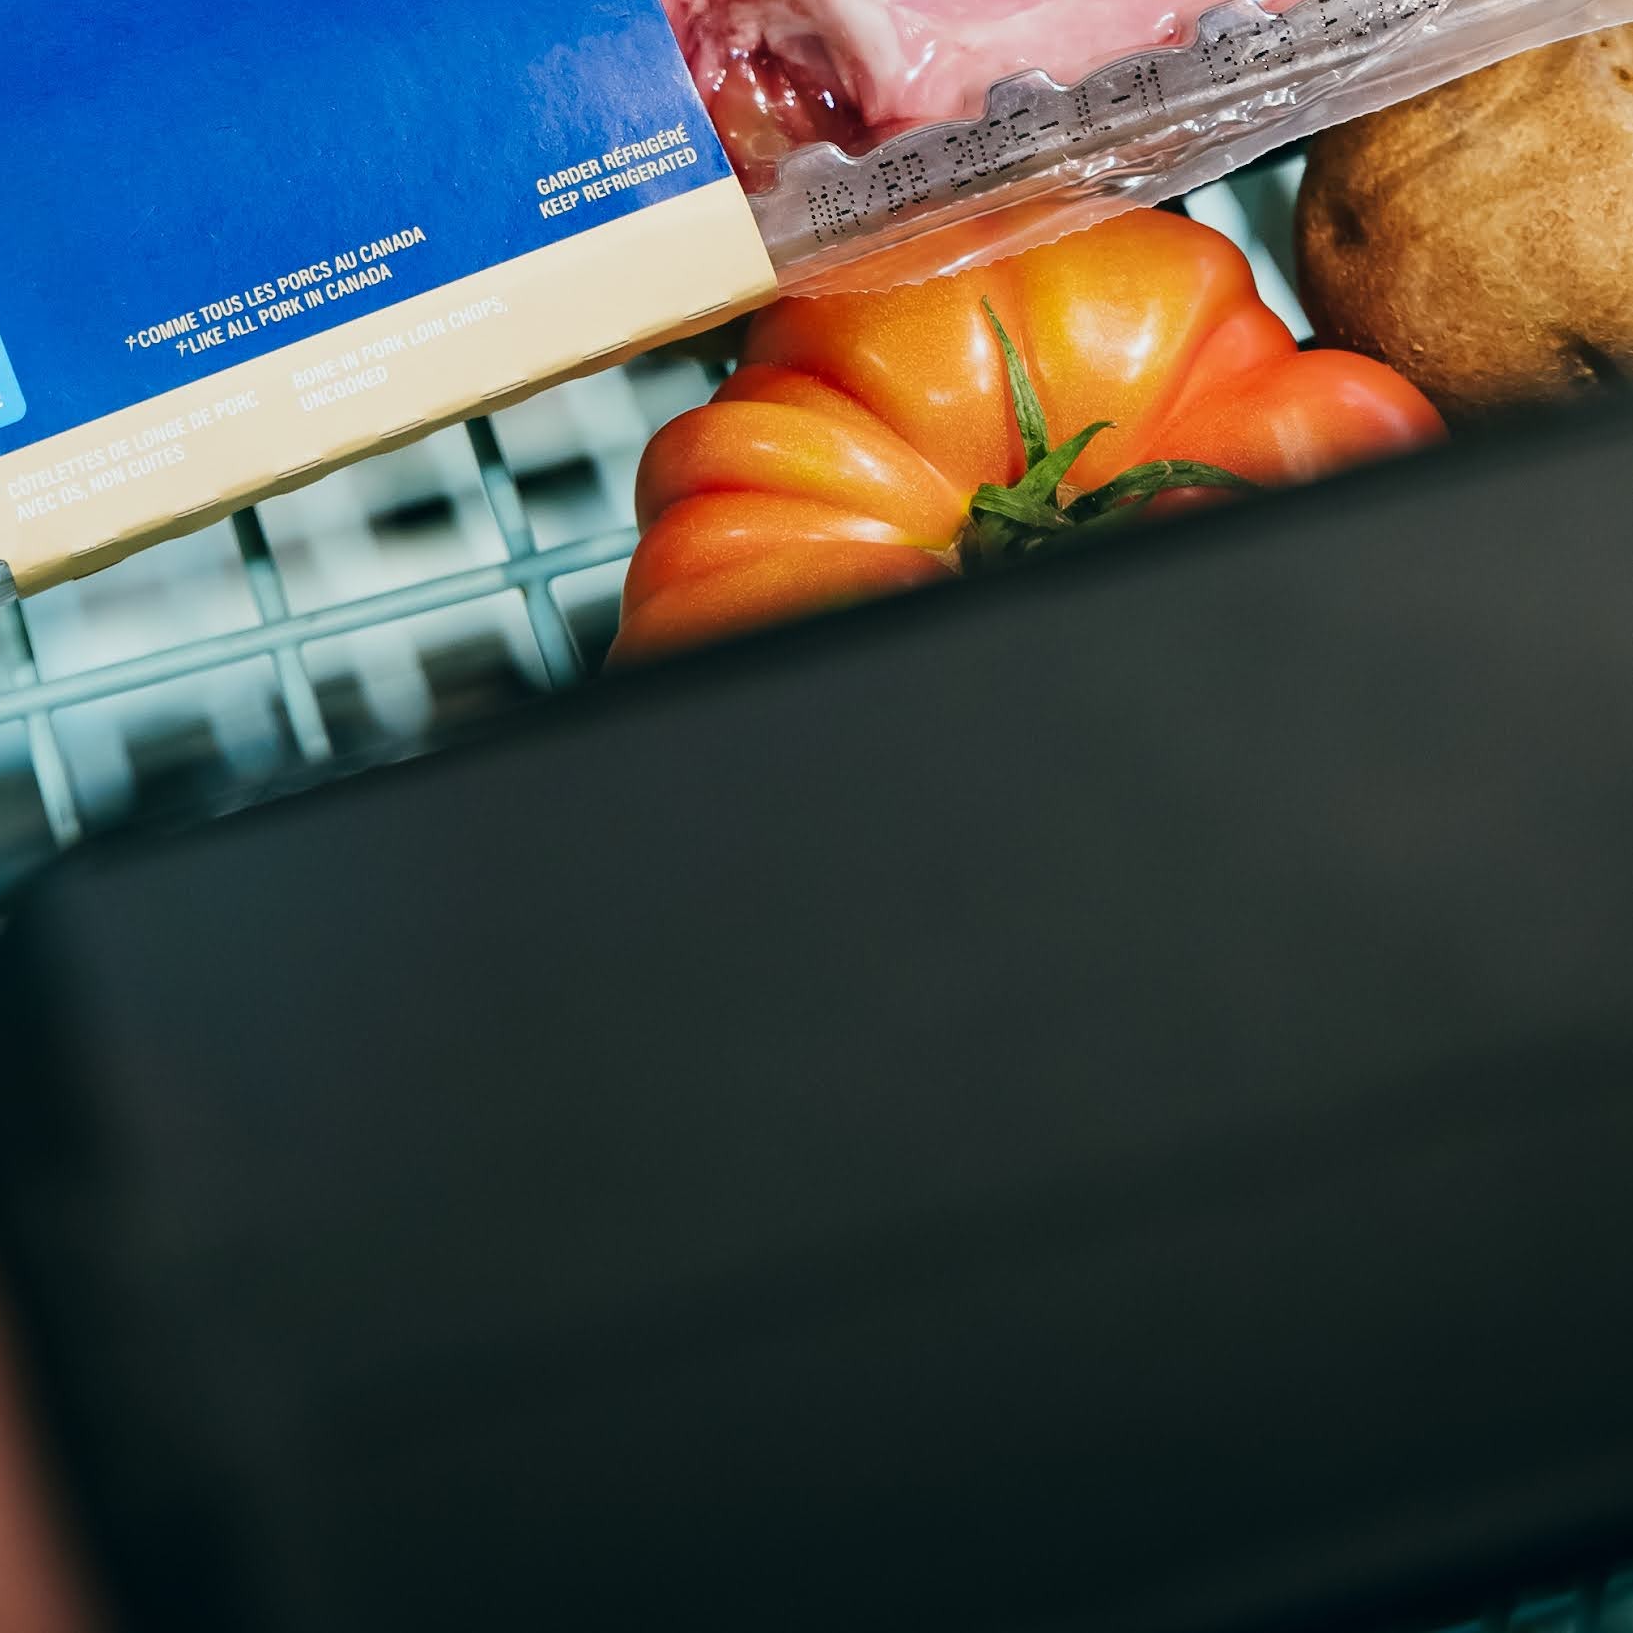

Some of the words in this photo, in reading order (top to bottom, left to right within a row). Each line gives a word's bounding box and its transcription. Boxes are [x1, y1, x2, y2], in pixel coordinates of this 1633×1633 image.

[536, 159, 602, 195] GARDER
[602, 122, 690, 170] RÉFRIGÉRÉ
[539, 191, 579, 219] KEEP
[582, 147, 698, 202] REFRIGERATED
[199, 295, 243, 324] TOUS
[245, 283, 276, 307] LES
[277, 261, 332, 294] PORCS
[336, 252, 357, 274] AU
[359, 226, 426, 263] CANADA
[229, 315, 258, 339] ALL
[258, 299, 304, 326] PORK
[304, 289, 324, 309] IN
[326, 263, 392, 300] CANADA
[362, 335, 407, 359] PORK
[408, 318, 446, 345] LOIN
[448, 295, 509, 329] CHOPS,
[300, 367, 387, 412] UNCOOKED
[8, 448, 106, 500] CÔTELETTES
[109, 439, 130, 461] DE
[133, 416, 187, 451] LONGE
[190, 408, 214, 430] DE
[16, 493, 57, 523] AVEC
[91, 465, 127, 493] NON
[129, 443, 185, 479] CUITES
